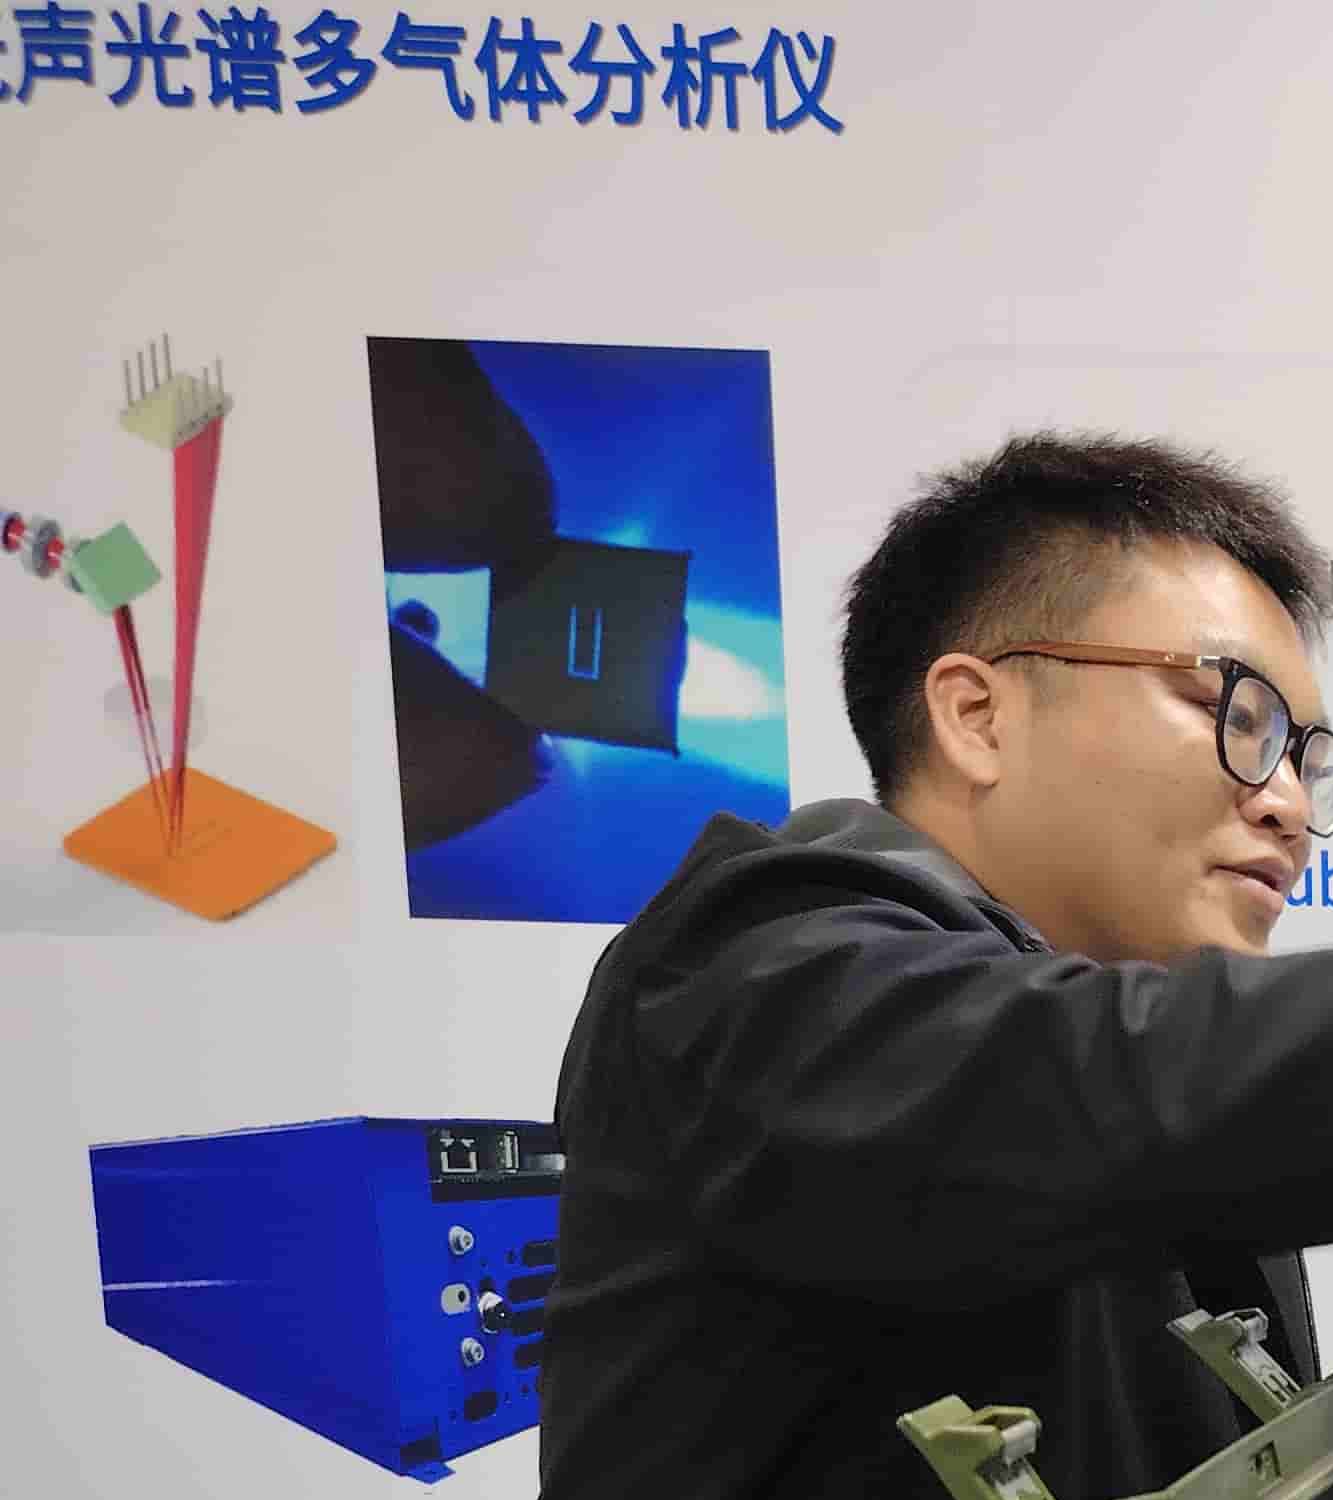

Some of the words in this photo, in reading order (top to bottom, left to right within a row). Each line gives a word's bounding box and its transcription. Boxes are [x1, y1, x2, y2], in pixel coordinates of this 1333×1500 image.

[0, 0, 845, 134] 声光谱多气体分析仪
